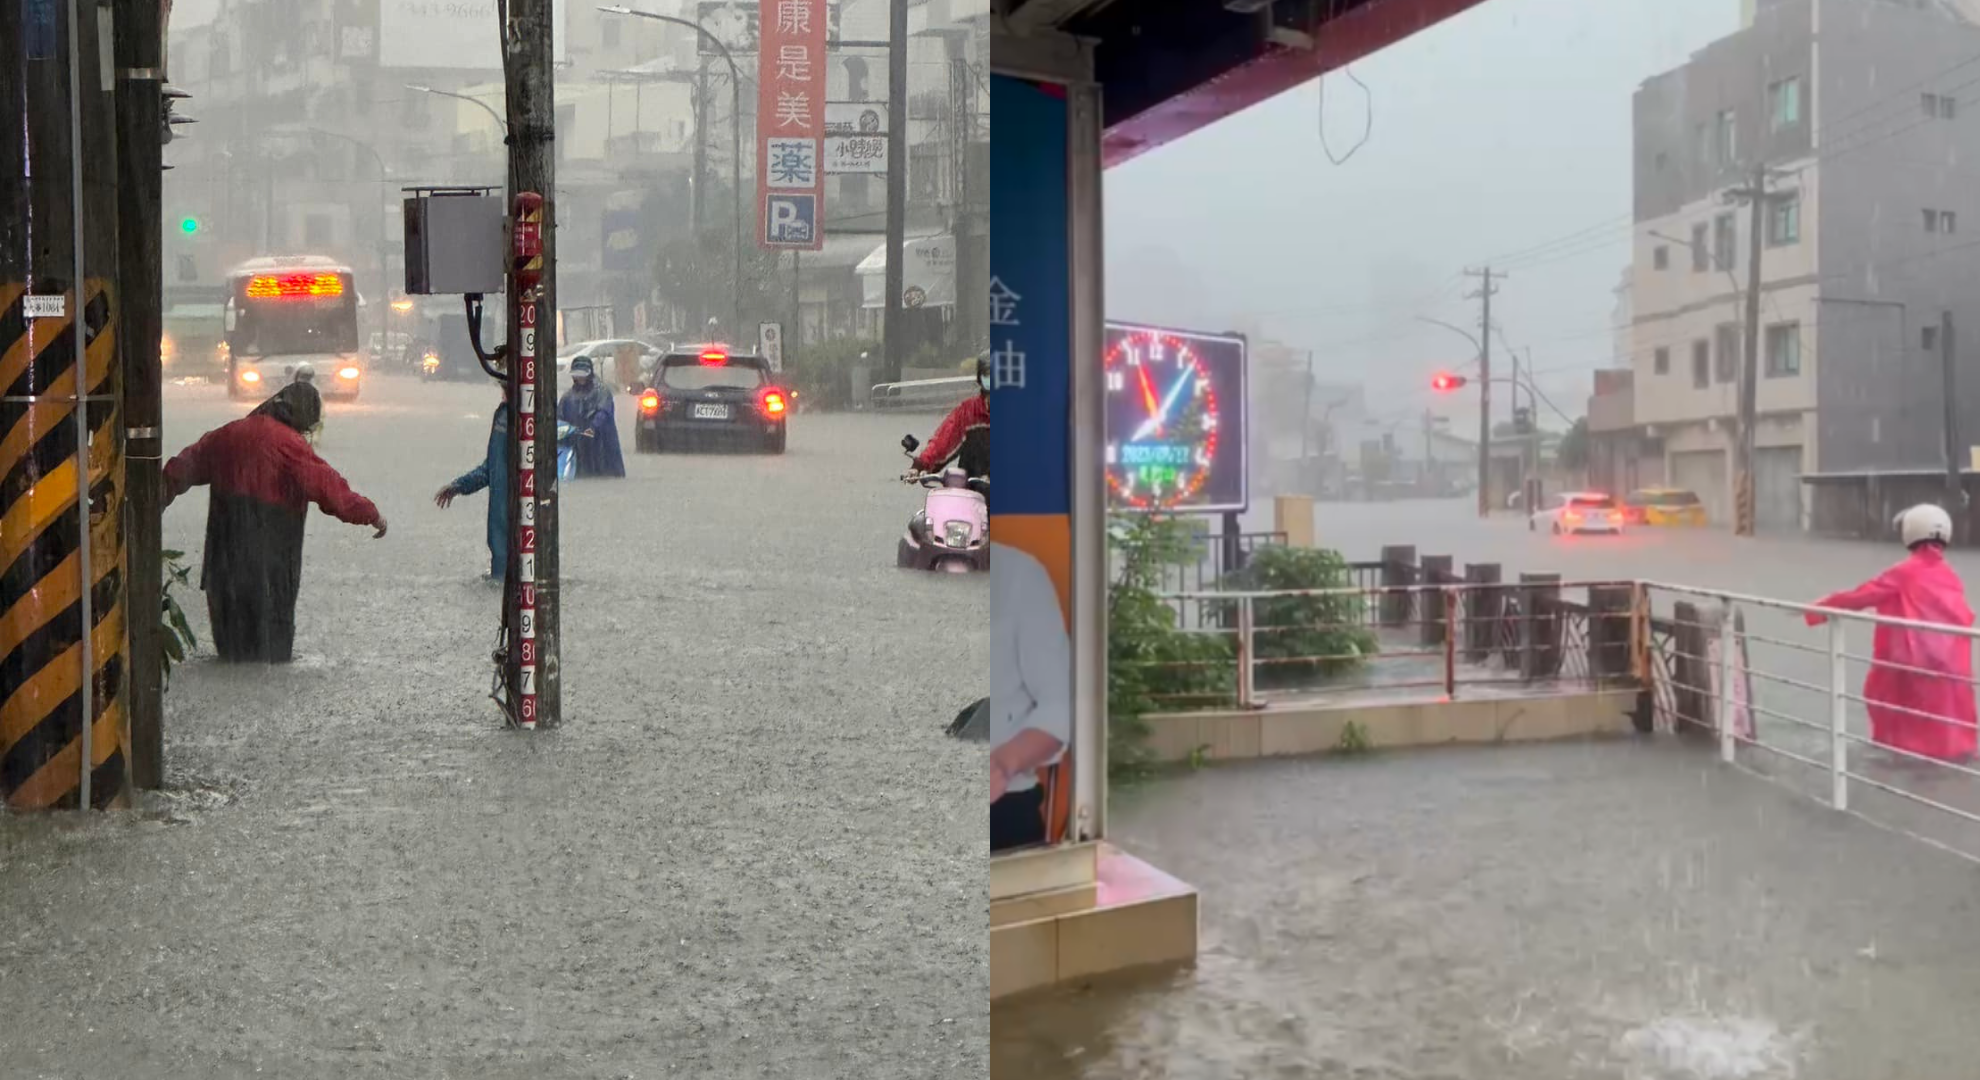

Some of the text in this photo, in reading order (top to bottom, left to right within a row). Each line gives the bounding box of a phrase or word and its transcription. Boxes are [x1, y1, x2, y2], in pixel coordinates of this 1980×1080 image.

[776, 0, 812, 128] 康是美
[771, 201, 797, 238] P
[521, 305, 535, 324] 20
[522, 615, 531, 633] 9
[521, 671, 532, 690] 7
